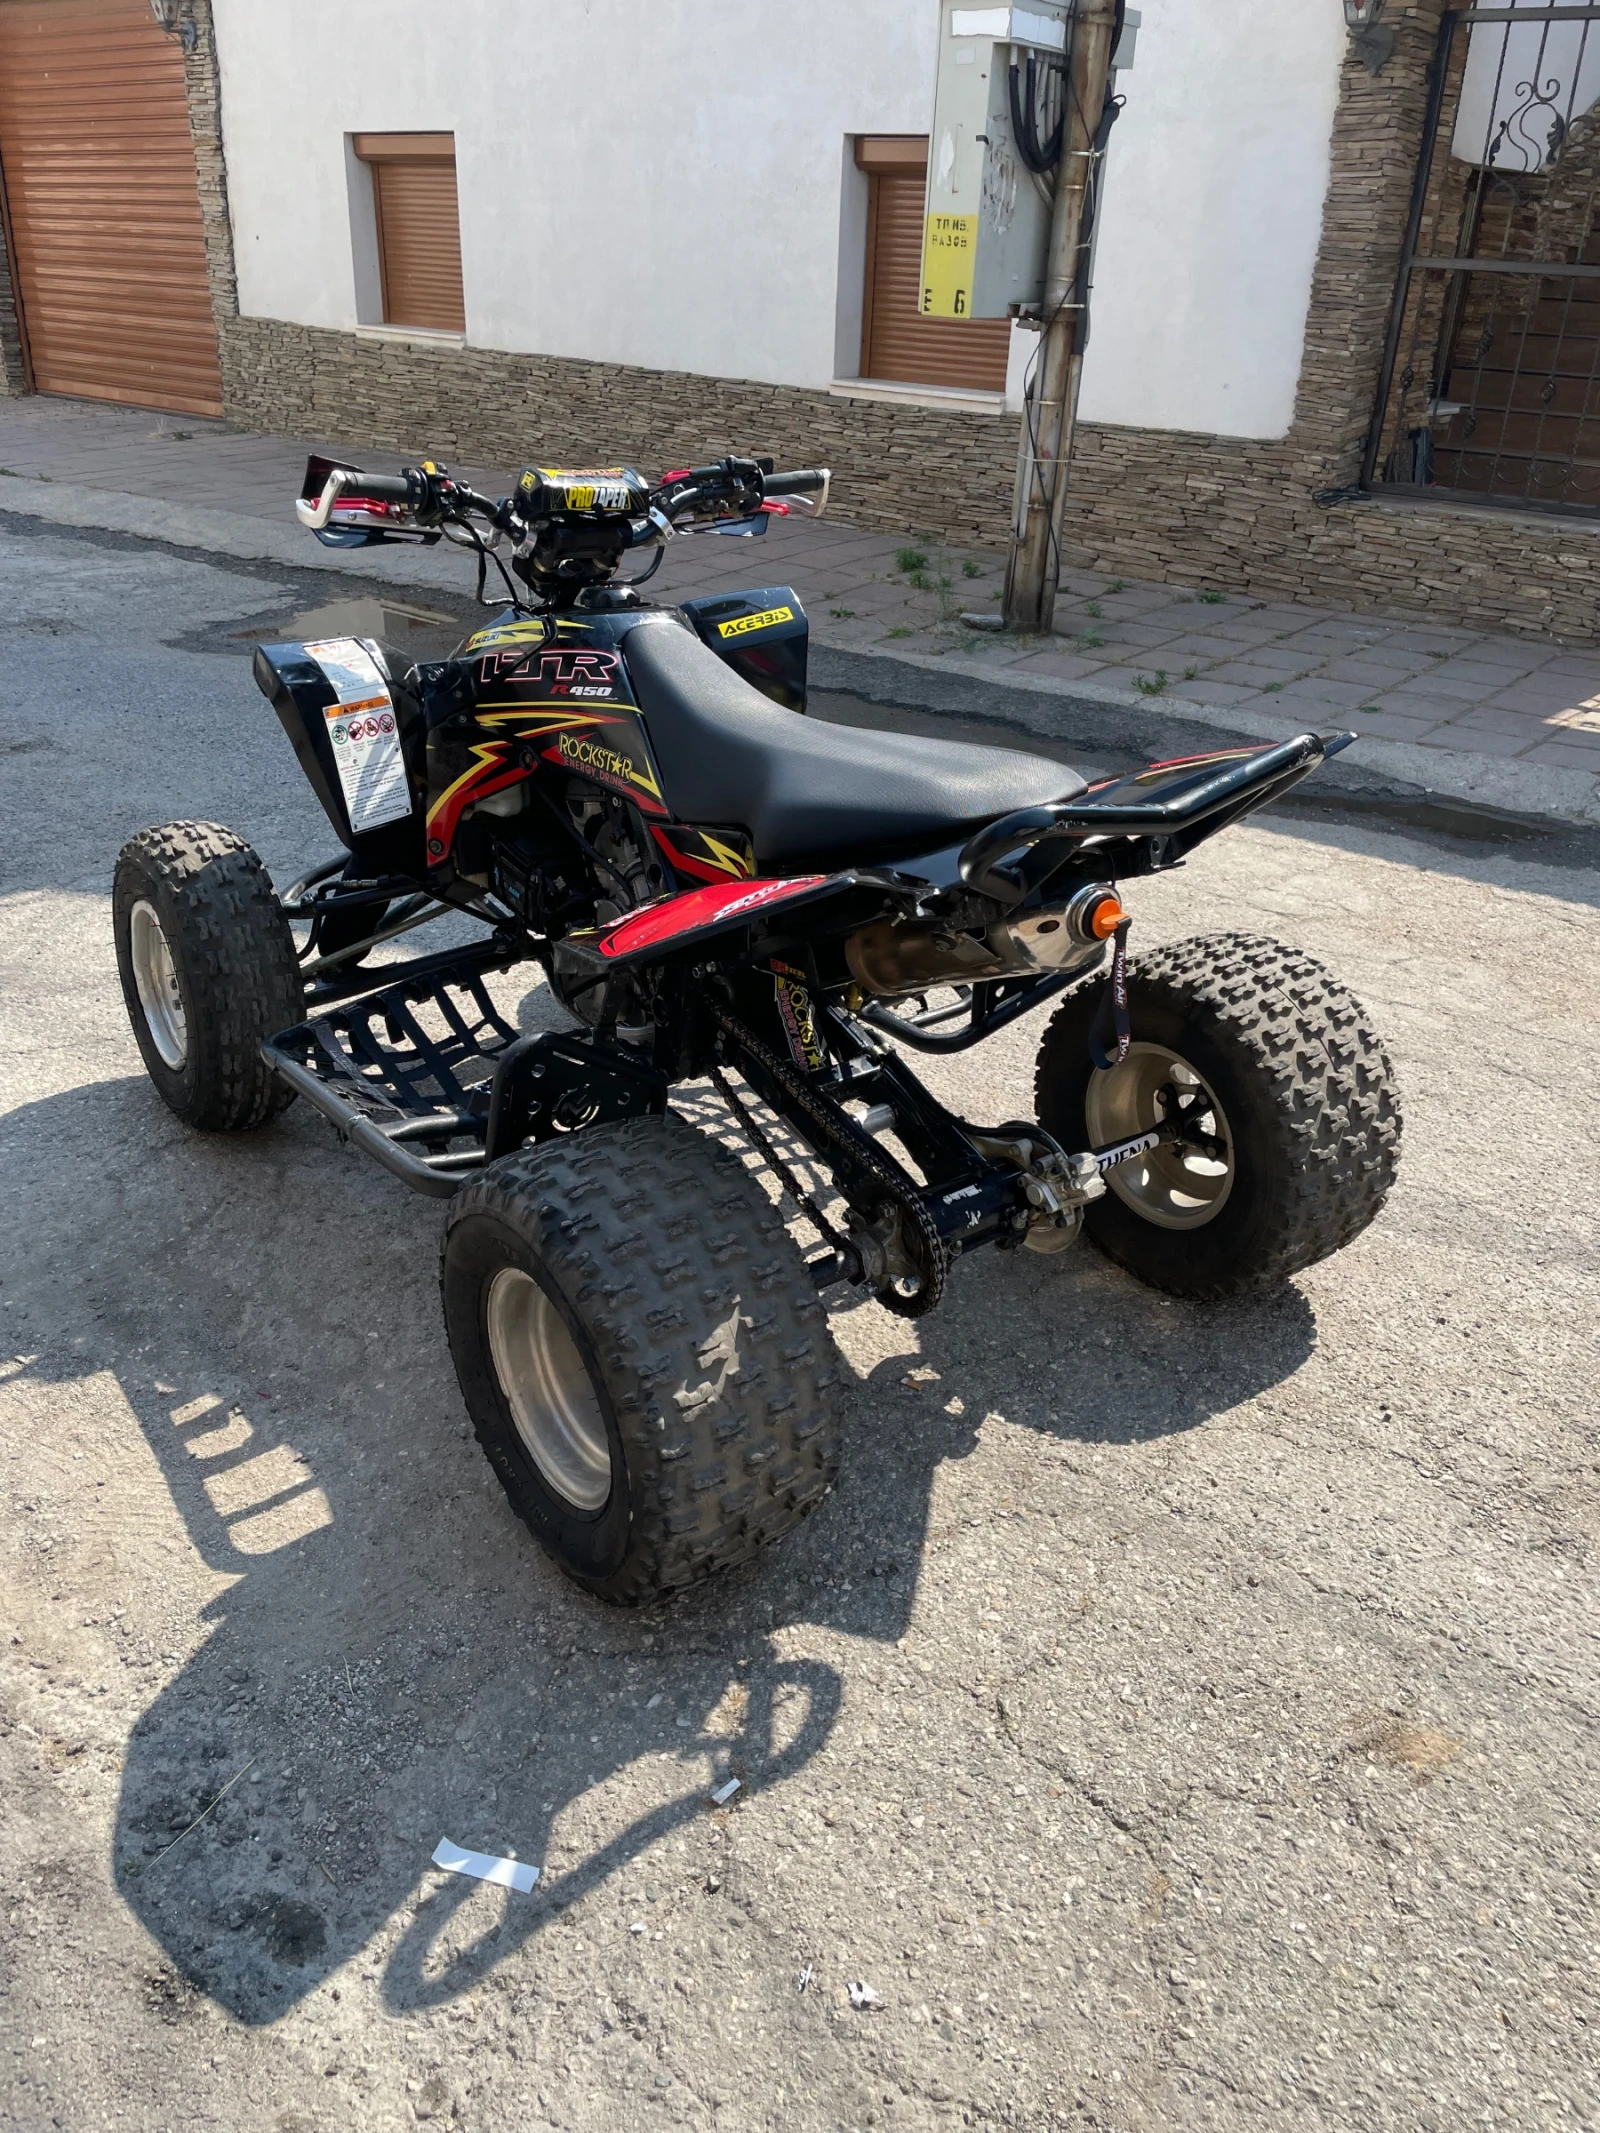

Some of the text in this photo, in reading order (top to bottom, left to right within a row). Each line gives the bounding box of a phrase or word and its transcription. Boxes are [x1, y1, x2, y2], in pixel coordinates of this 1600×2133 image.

[551, 684, 613, 697] R450
[565, 756, 625, 790] ENERGY DRINK
